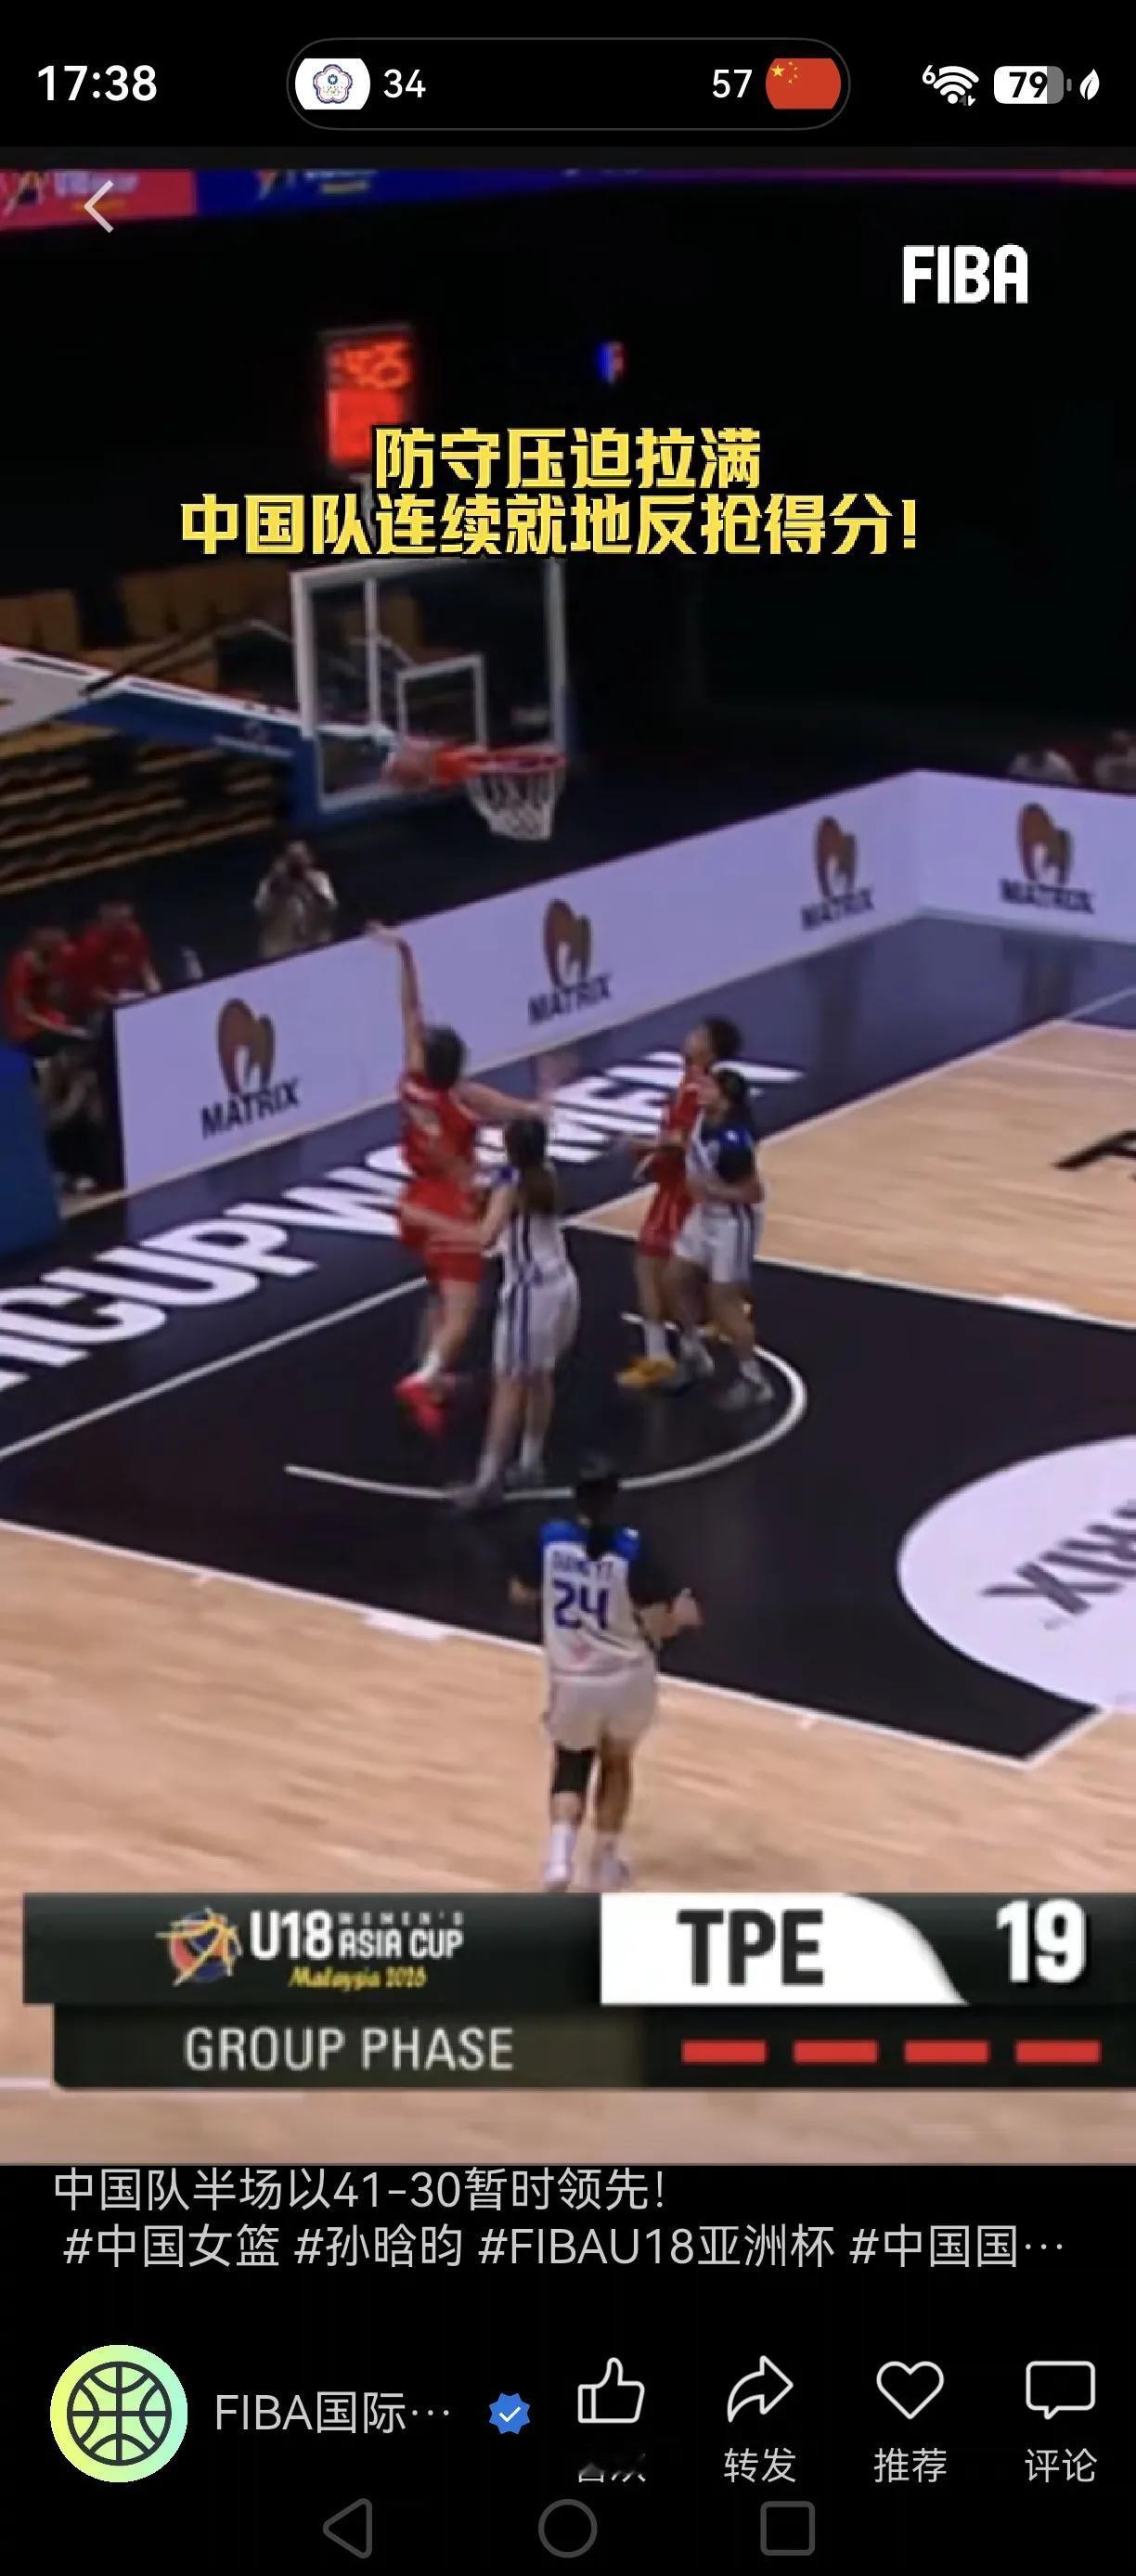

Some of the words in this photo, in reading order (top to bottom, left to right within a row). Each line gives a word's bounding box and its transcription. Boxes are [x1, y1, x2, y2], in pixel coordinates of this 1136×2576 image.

[527, 974, 614, 1024] MATRIX
[200, 1077, 301, 1140] MATRIX
[553, 1579, 610, 1630] 24
